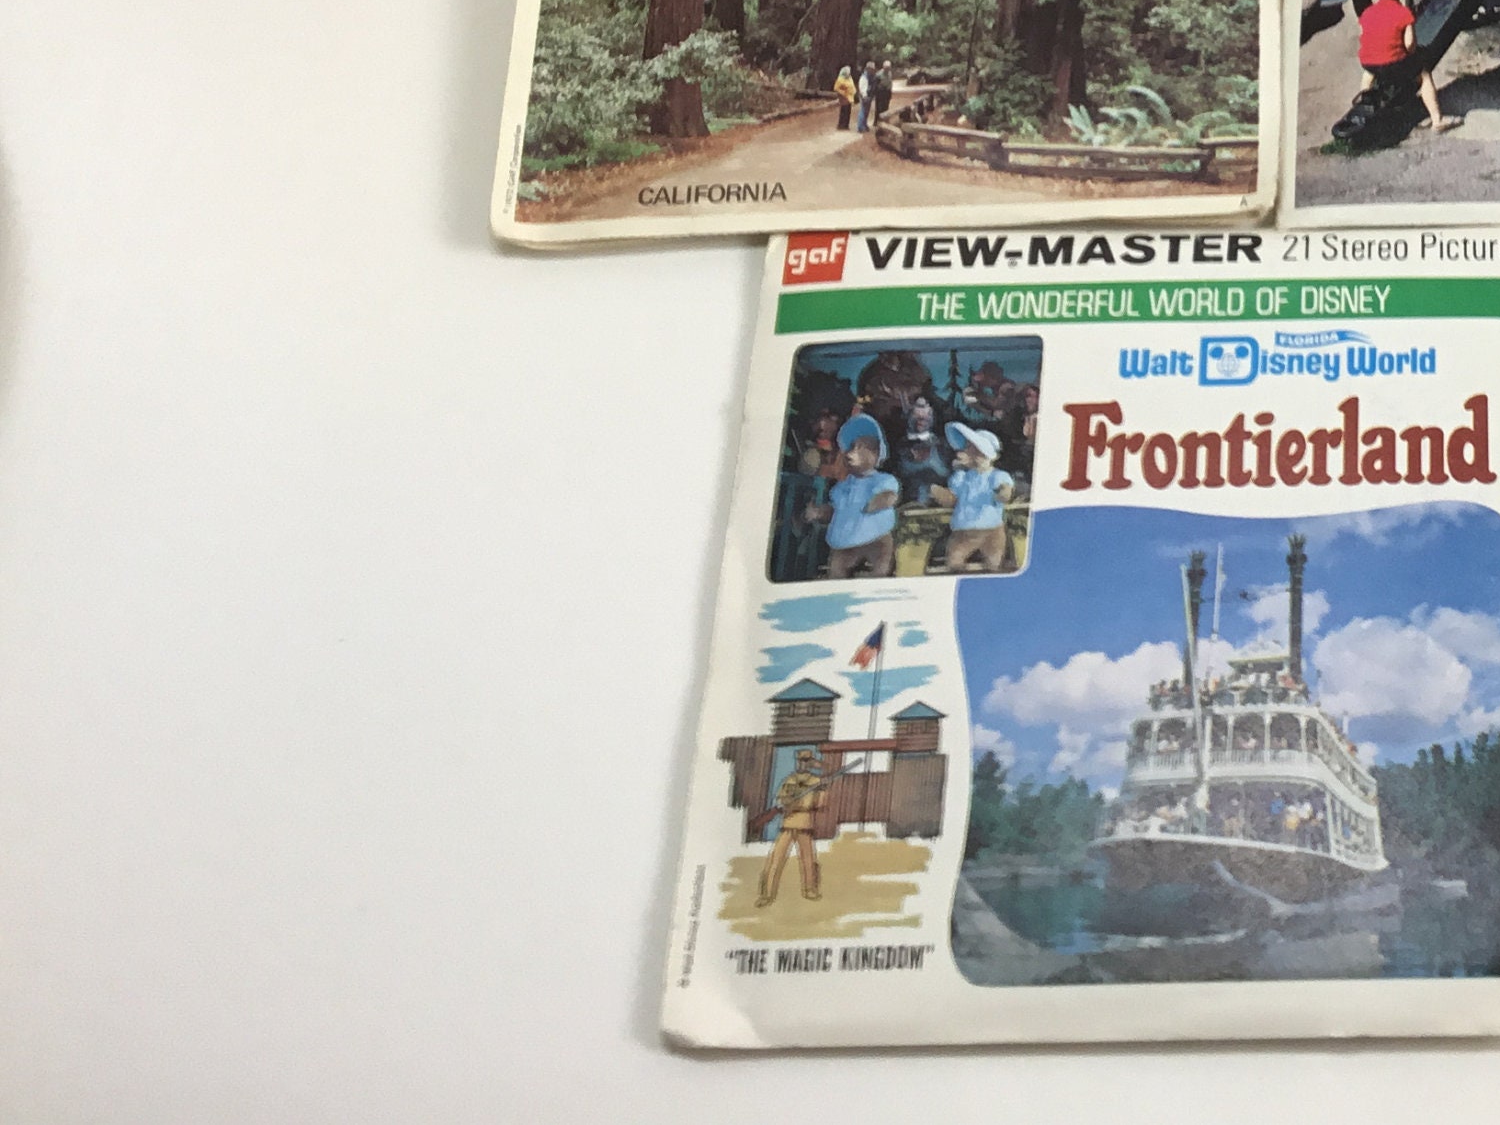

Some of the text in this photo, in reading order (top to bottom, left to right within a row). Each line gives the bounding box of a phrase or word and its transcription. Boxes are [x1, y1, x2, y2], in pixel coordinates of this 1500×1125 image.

[638, 181, 787, 206] CALIFORNIA
[1239, 195, 1248, 207] A
[788, 237, 846, 275] gaf
[865, 234, 1262, 270] VIEW-MASTER
[1282, 234, 1310, 262] 21
[1321, 234, 1408, 262] Stereo
[917, 284, 1391, 321] THE WONDERFUL WORLD OF DISNEY
[1279, 331, 1340, 347] FLORIDA
[1119, 335, 1436, 387] Walt Disney World
[1060, 393, 1497, 492] Frontierland
[775, 946, 832, 973] MAGIC
